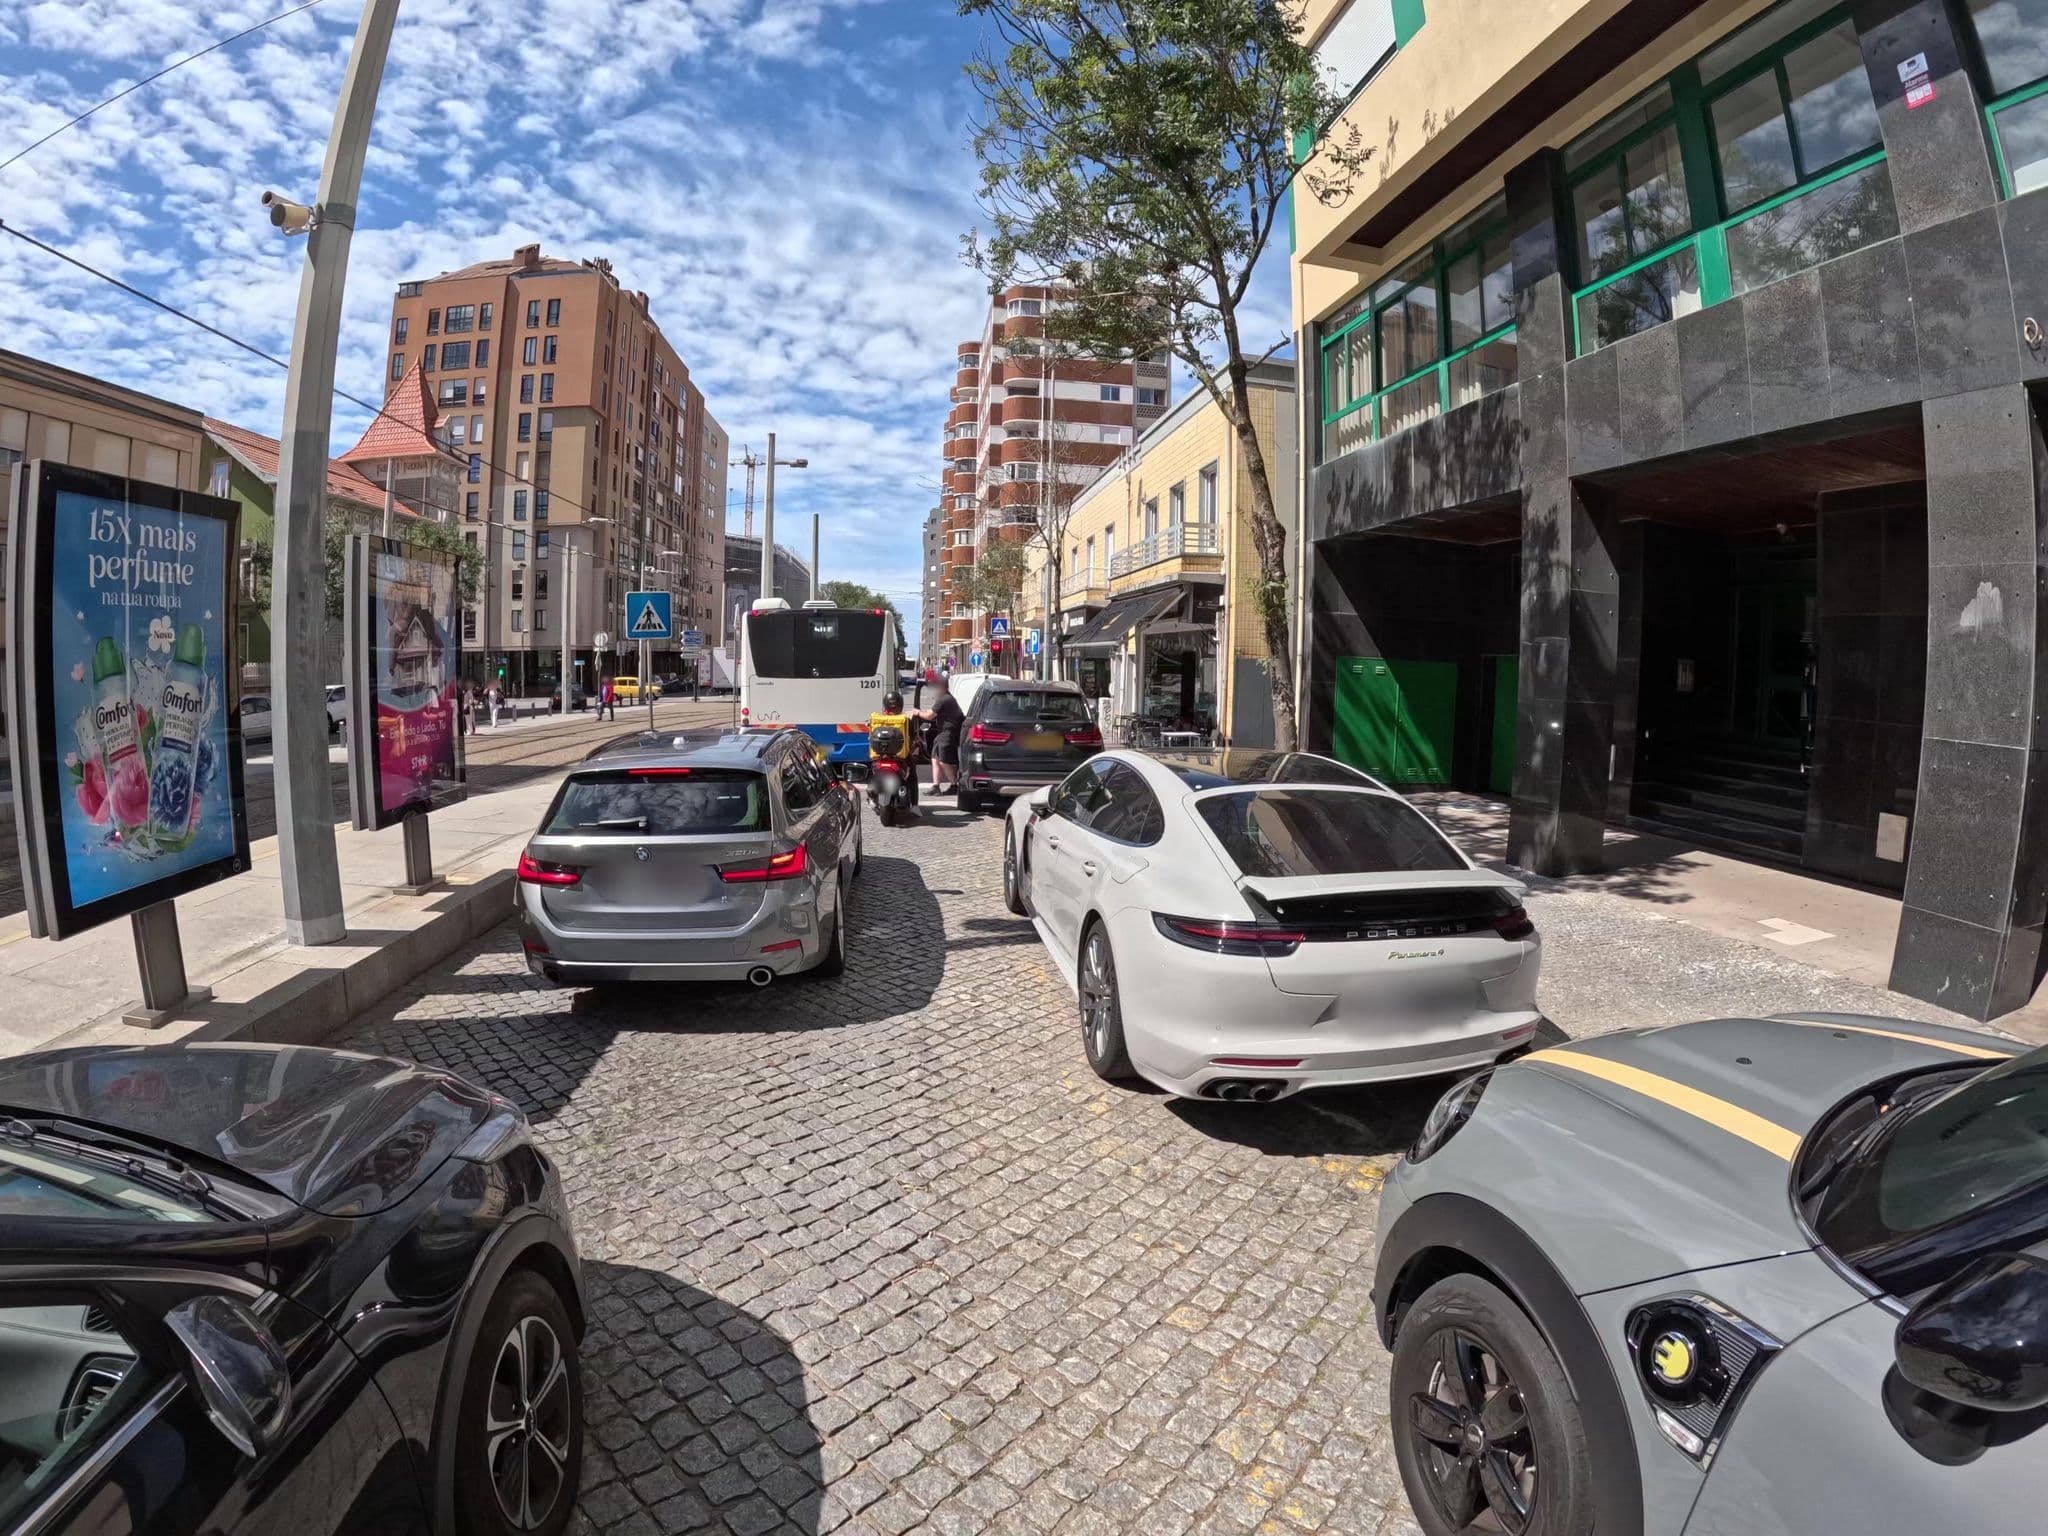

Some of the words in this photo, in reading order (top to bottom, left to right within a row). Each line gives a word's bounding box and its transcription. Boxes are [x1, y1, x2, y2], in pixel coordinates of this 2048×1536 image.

[139, 524, 196, 553] mais
[88, 548, 194, 590] perfume
[101, 591, 118, 605] na
[120, 592, 142, 607] tua
[145, 594, 182, 612] roupa
[153, 631, 173, 640] Novo
[859, 680, 881, 689] 1201
[162, 685, 203, 714] Comfort
[95, 697, 135, 730] Comfort
[1346, 925, 1466, 939] PORSCHE
[1388, 951, 1437, 960] Panamera
